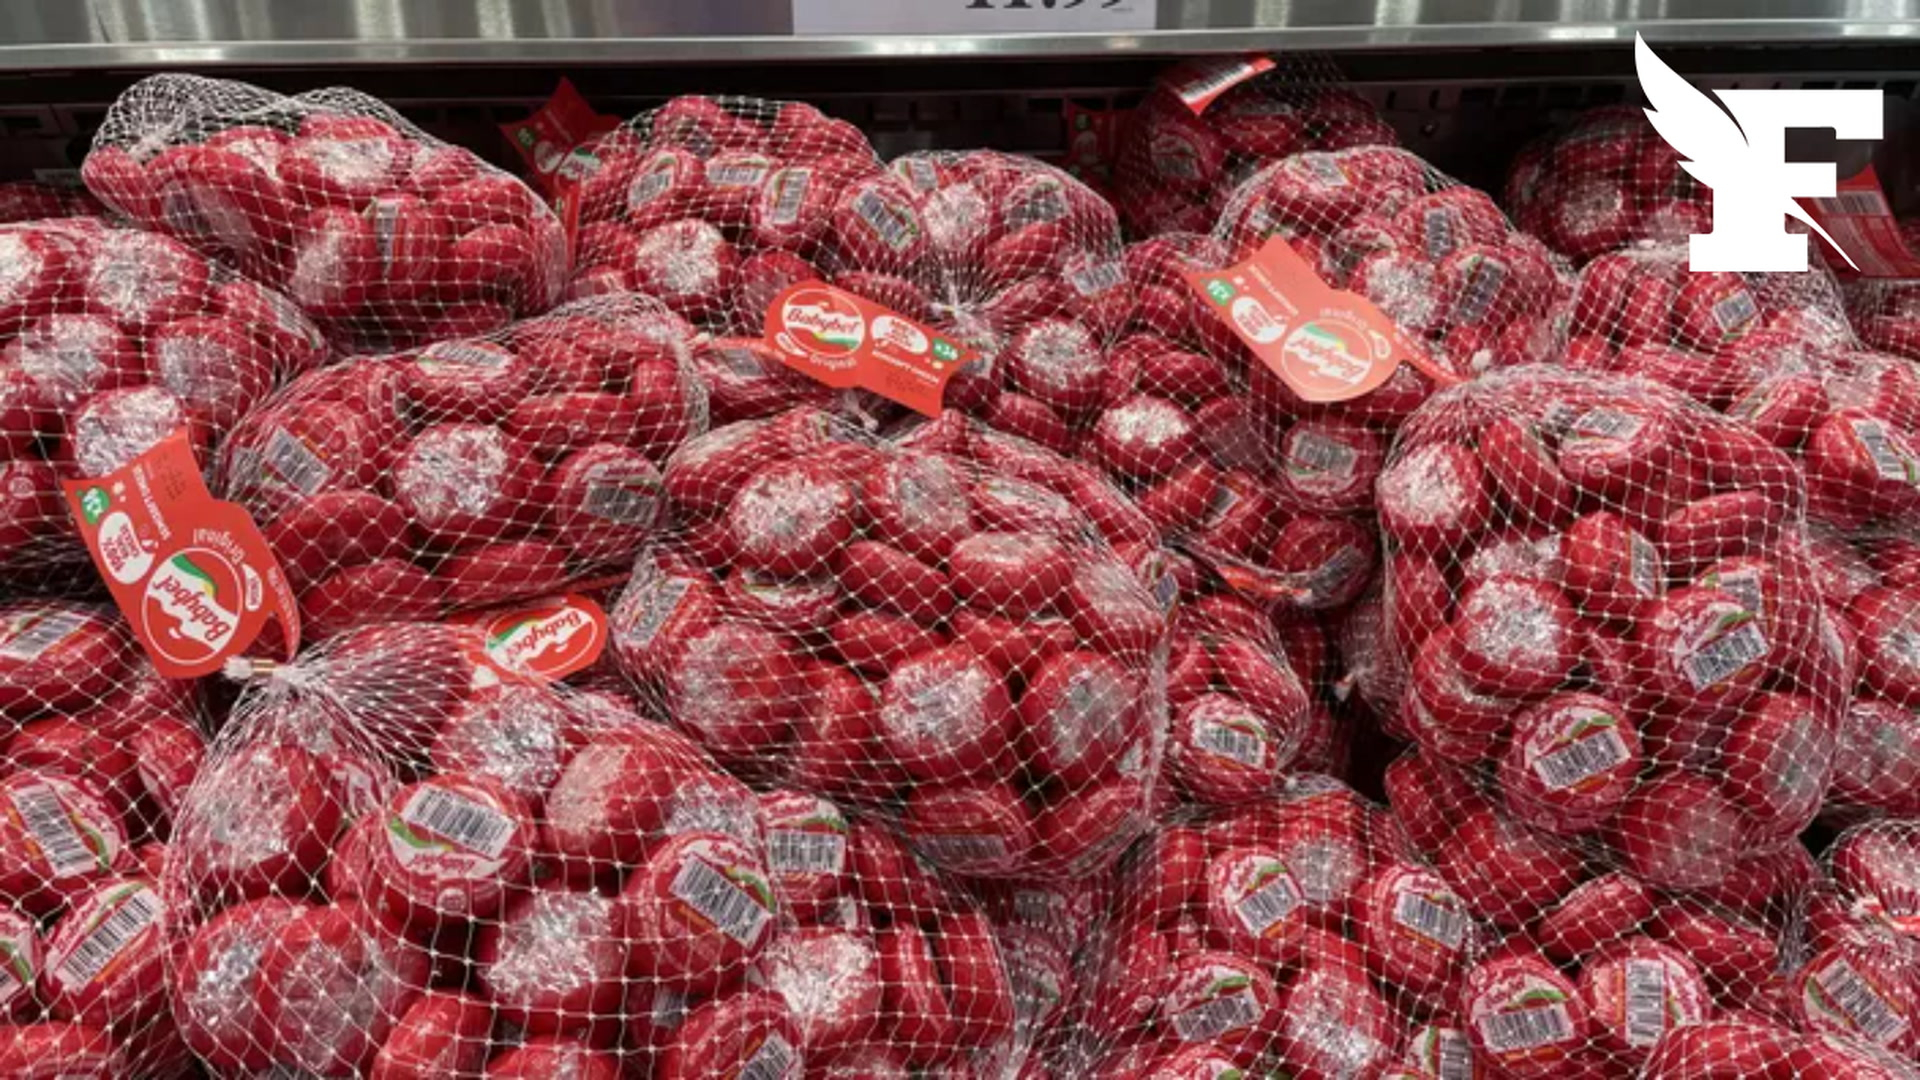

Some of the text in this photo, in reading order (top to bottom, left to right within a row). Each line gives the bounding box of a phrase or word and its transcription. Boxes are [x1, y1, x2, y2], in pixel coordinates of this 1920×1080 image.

[787, 307, 860, 335] Babybel
[193, 528, 247, 565] Original
[152, 575, 231, 642] Babybel
